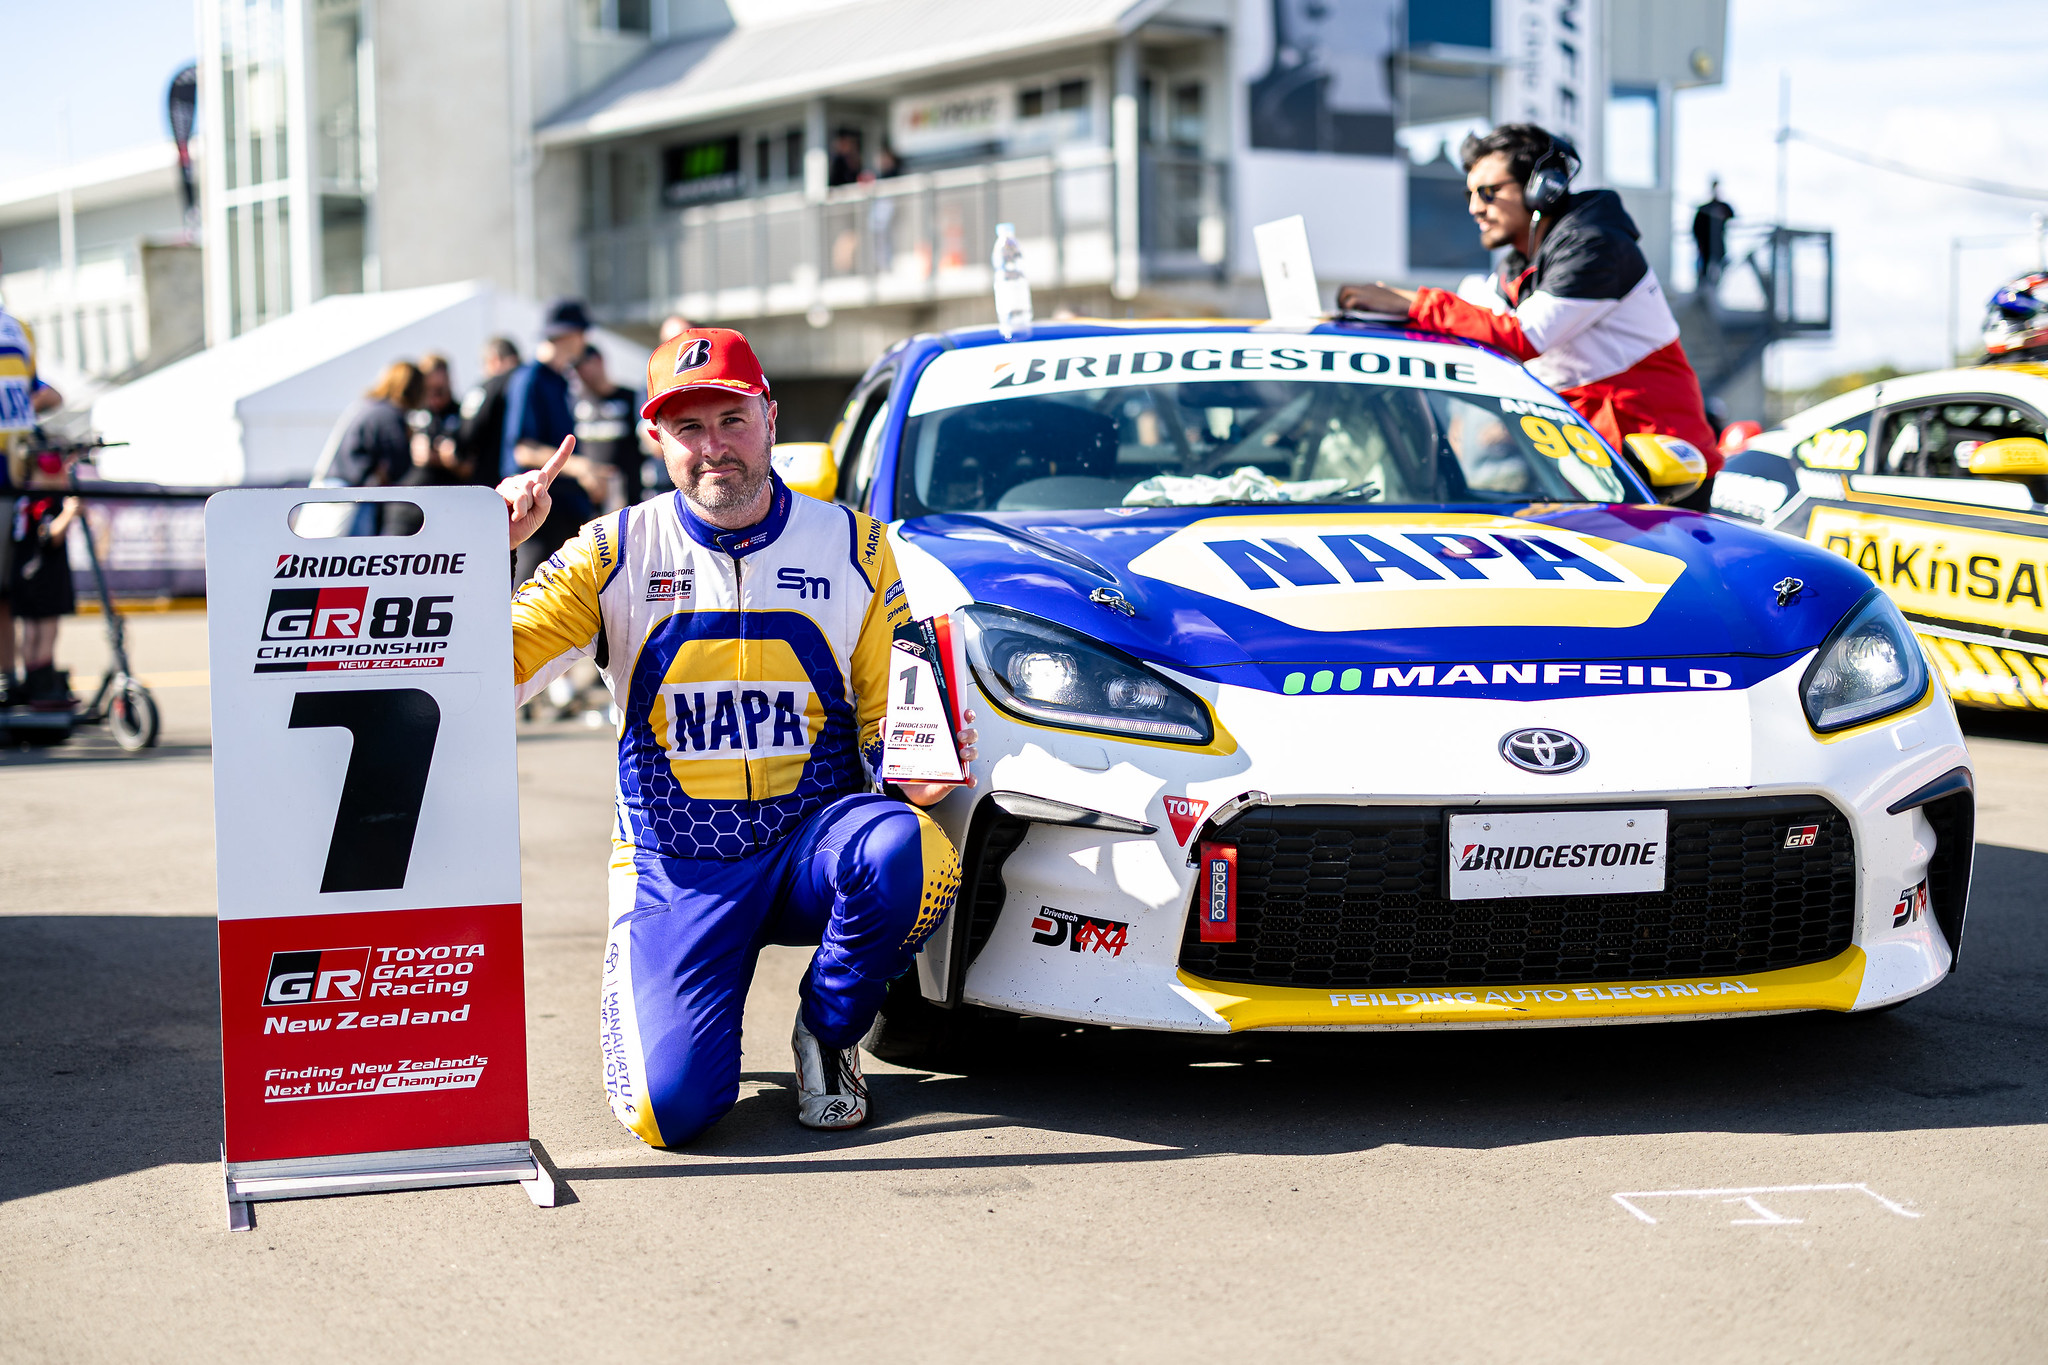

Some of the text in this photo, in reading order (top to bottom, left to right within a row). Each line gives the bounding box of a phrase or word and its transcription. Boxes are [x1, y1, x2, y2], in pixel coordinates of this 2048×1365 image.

[989, 347, 1477, 390] BRIDGESTONE
[1519, 415, 1612, 469] 99
[273, 553, 467, 579] BRIDGESTONE
[1202, 533, 1626, 591] NAPA
[368, 595, 454, 640] 86
[256, 641, 448, 660] CHAMPIONSHIP
[338, 657, 439, 670] NEW ZEALAND
[899, 665, 919, 705] 1
[1371, 663, 1733, 689] MANFEILD
[673, 689, 805, 752] NAPA
[914, 733, 936, 744] 86
[287, 687, 442, 894] 1
[1167, 799, 1204, 818] TOW
[1787, 833, 1815, 847] GR
[1458, 841, 1659, 873] BRIDGESTONE
[1212, 860, 1227, 921] sparco
[1043, 907, 1078, 923] Drivetech
[372, 961, 474, 980] GAZOO
[267, 968, 362, 1002] GR
[369, 978, 469, 998] Racing
[1329, 979, 1759, 1007] FEILDING AUTO ELECTRICAL
[263, 1003, 471, 1036] New Zealand
[264, 1054, 489, 1081] Finding New Zealand's
[264, 1071, 477, 1097] Next World Champion
[823, 1101, 850, 1122] OMP
